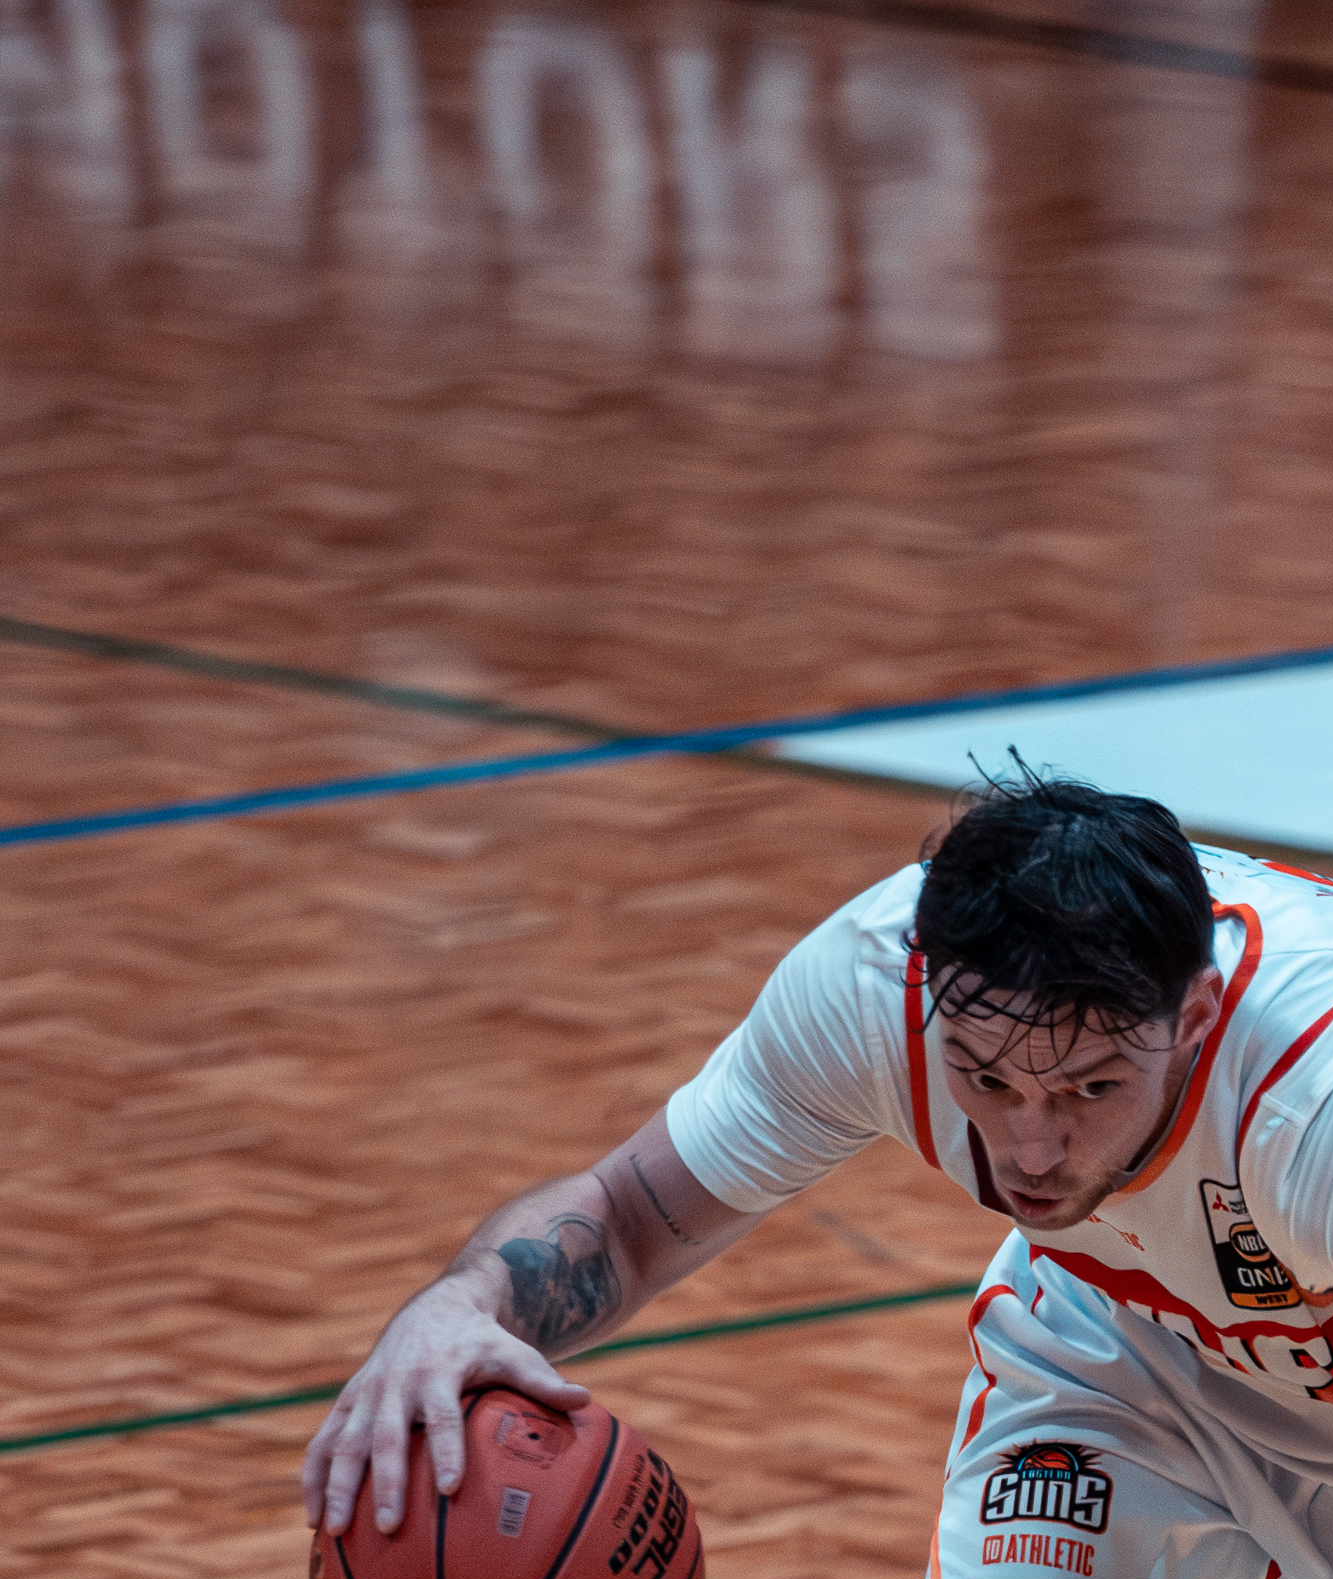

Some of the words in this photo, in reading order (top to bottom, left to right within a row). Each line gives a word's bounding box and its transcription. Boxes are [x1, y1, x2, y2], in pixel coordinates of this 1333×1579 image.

[1237, 1234, 1267, 1252] NBL
[1255, 1294, 1289, 1305] WEST
[1004, 1534, 1095, 1577] ATHLETIC
